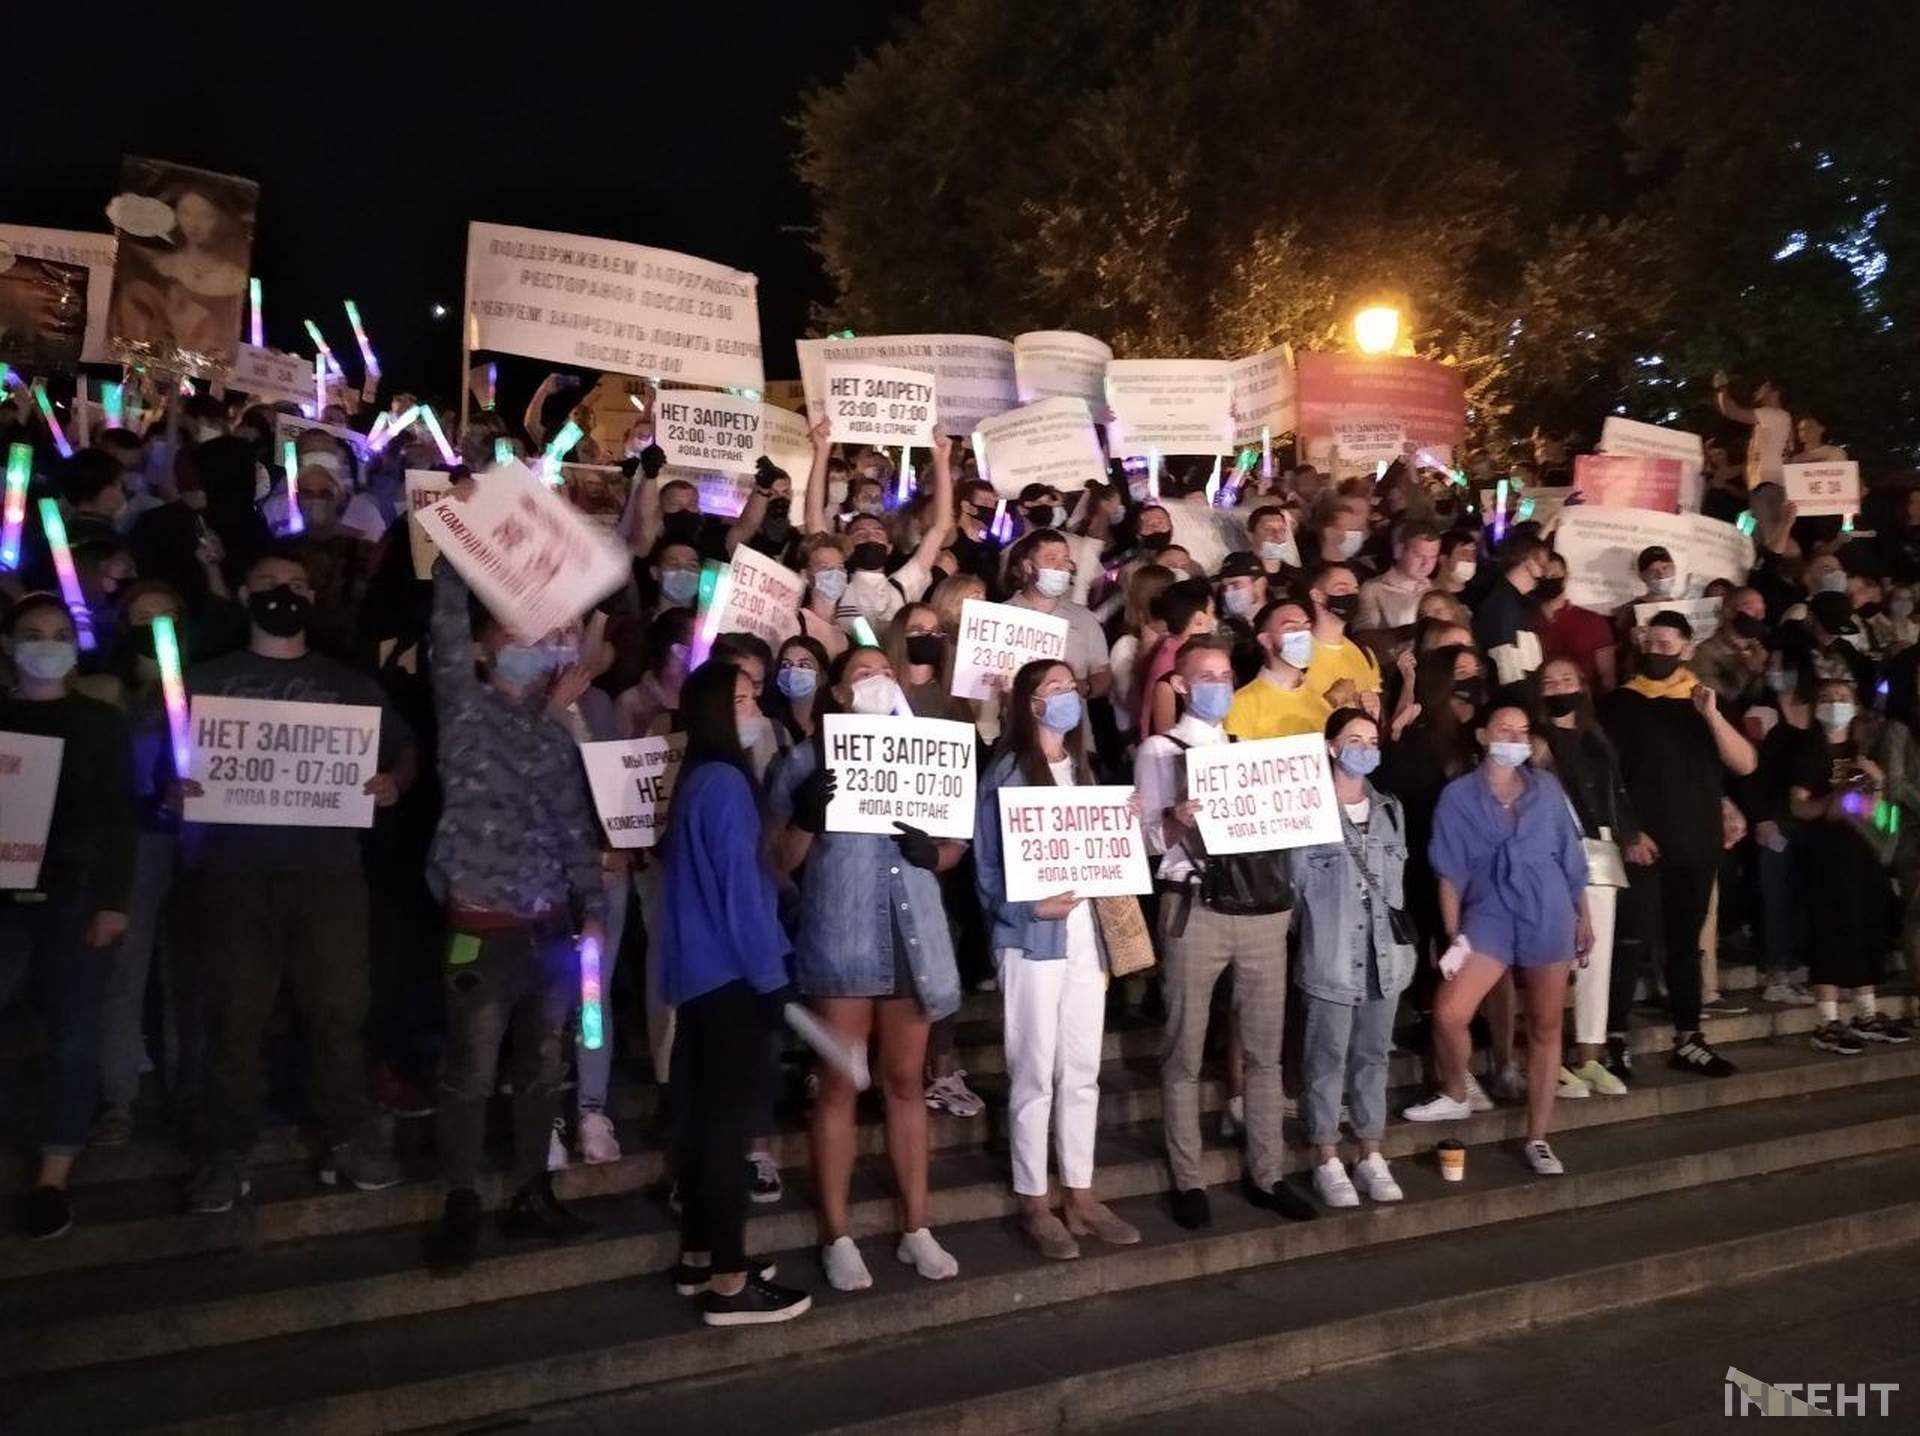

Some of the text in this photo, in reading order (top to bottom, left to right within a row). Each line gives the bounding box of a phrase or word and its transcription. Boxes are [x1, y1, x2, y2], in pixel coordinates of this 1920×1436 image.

[831, 378, 860, 396] НЕТ
[864, 379, 933, 402] ЗАПРЕТУ
[660, 403, 690, 424] НЕТ
[693, 408, 760, 432] ЗАПРЕТУ
[838, 400, 877, 418] 23:00
[889, 403, 928, 421] 07:00
[668, 424, 705, 444] 23:00
[716, 431, 754, 450] 07:00
[677, 445, 744, 463] #ОПА В СТРАНЕ
[733, 560, 758, 588] НЕТ
[730, 588, 766, 615] 23:00
[966, 616, 1064, 657] НЕТ ЗАПРЕТУ
[972, 646, 1016, 671] 23:00
[197, 718, 374, 756] НЕТ ЗАПРЕТУ
[621, 754, 645, 769] МЫ
[833, 734, 971, 769] НЕТ ЗАПРЕТУ
[208, 755, 275, 782] 23:00
[296, 760, 360, 787] 07:00
[846, 767, 897, 793] 23:00
[915, 772, 963, 798] 07:00
[1195, 753, 1321, 794] НЕТ ЗАПРЕТУ
[224, 788, 342, 809] #ОПА В СТРАНЕ
[635, 775, 669, 803] НЕ
[859, 799, 950, 820] #ОПА В СТРАНЕ
[1207, 794, 1257, 820] 23:00
[1273, 786, 1322, 813] 07:00
[1008, 805, 1133, 833] НЕТ ЗАПРЕТУ
[1227, 822, 1257, 839] #ОПА
[1270, 815, 1313, 835] СТРАНЕ
[1021, 838, 1070, 861] 23:00
[1085, 837, 1131, 859] 07:00
[1038, 864, 1124, 882] #ОПА В СТРАНЕ
